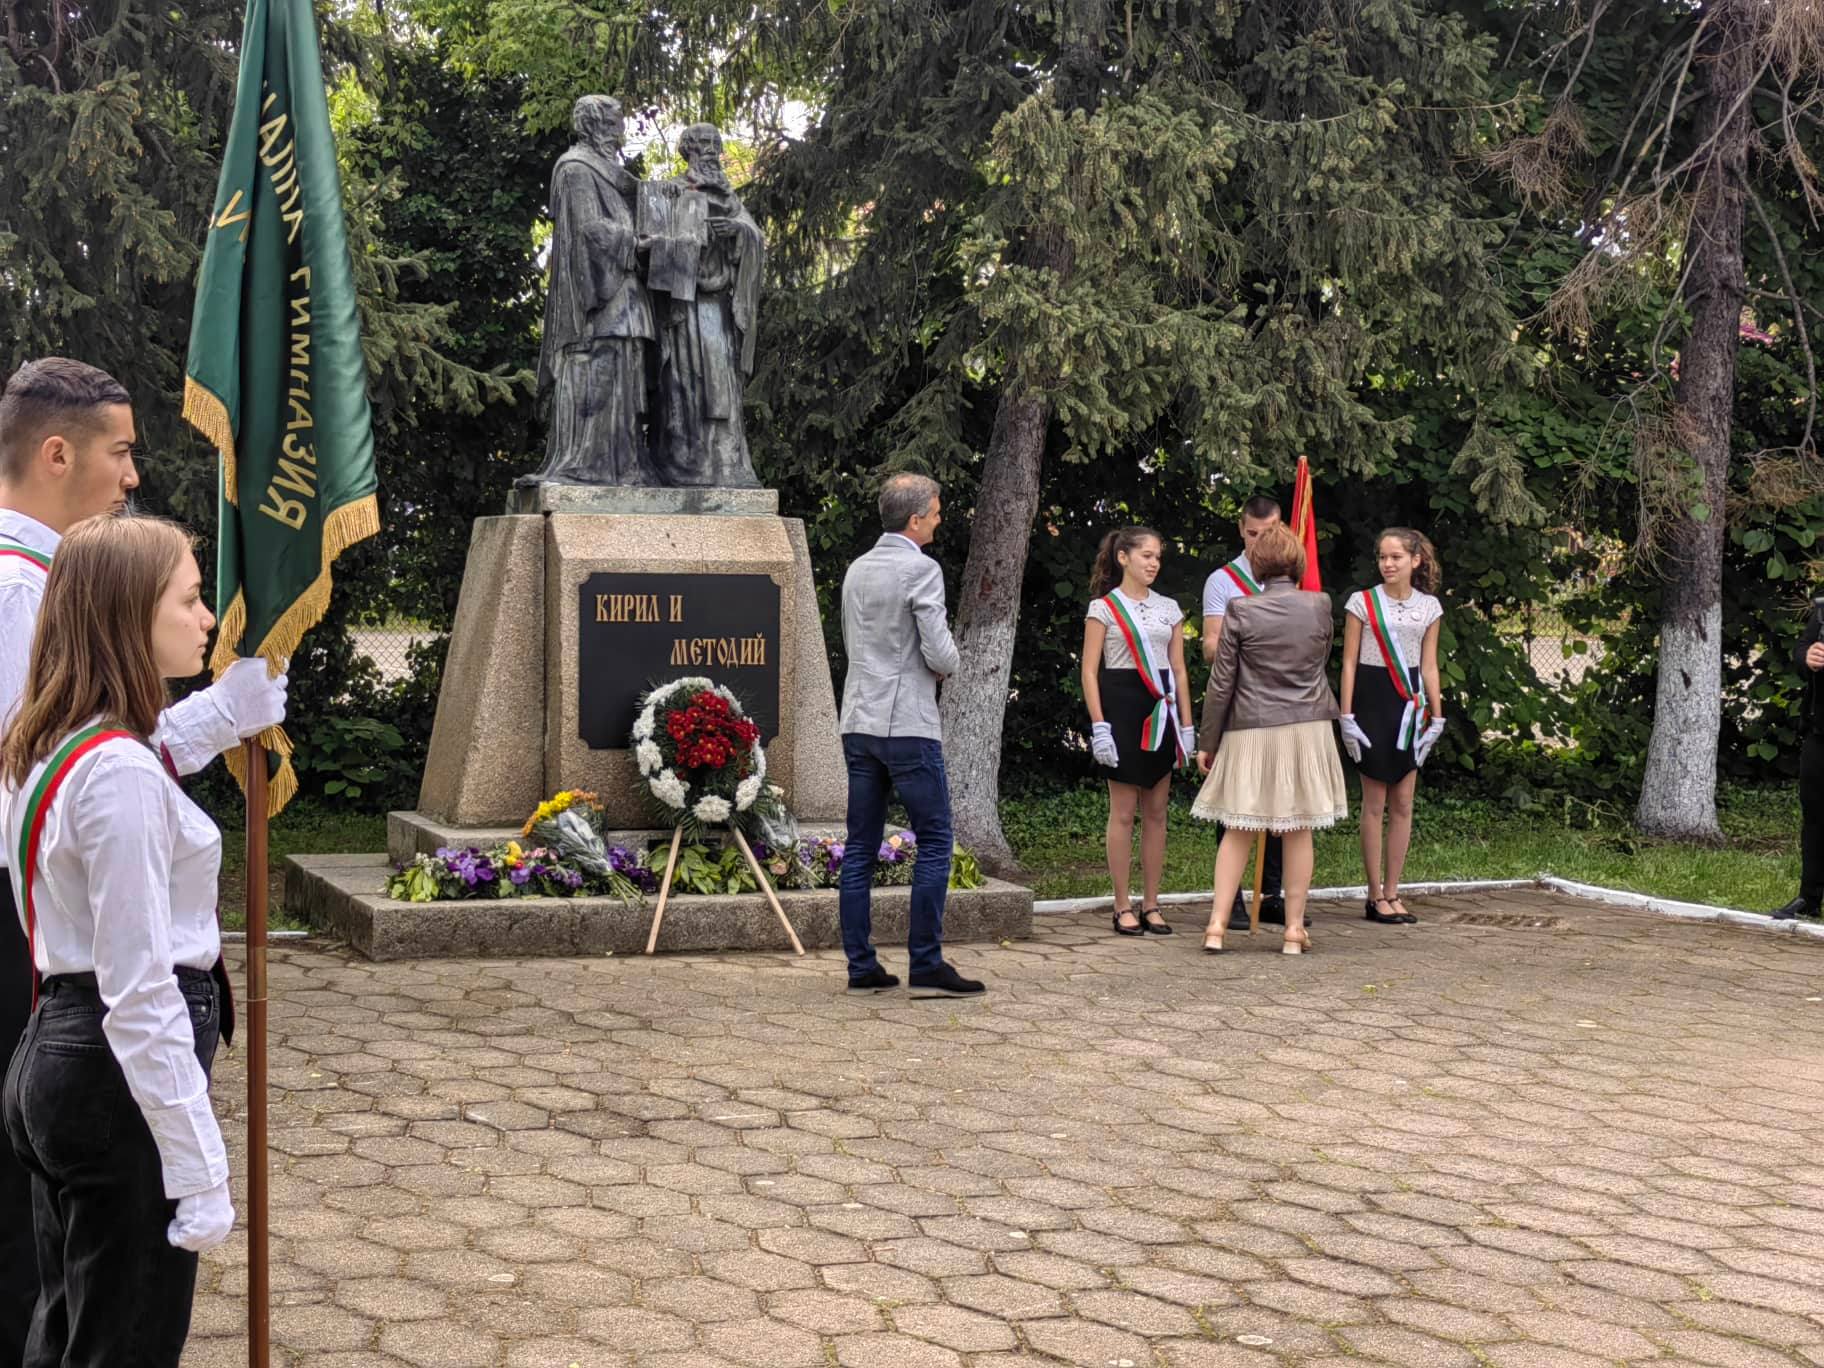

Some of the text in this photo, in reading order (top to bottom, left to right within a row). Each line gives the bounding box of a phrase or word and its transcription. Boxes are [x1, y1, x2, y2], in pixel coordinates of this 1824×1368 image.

[258, 265, 318, 531] ГИМНАЗИЯ
[595, 594, 683, 622] КИРИЛ И
[670, 632, 766, 669] МЕТОДИЙ
